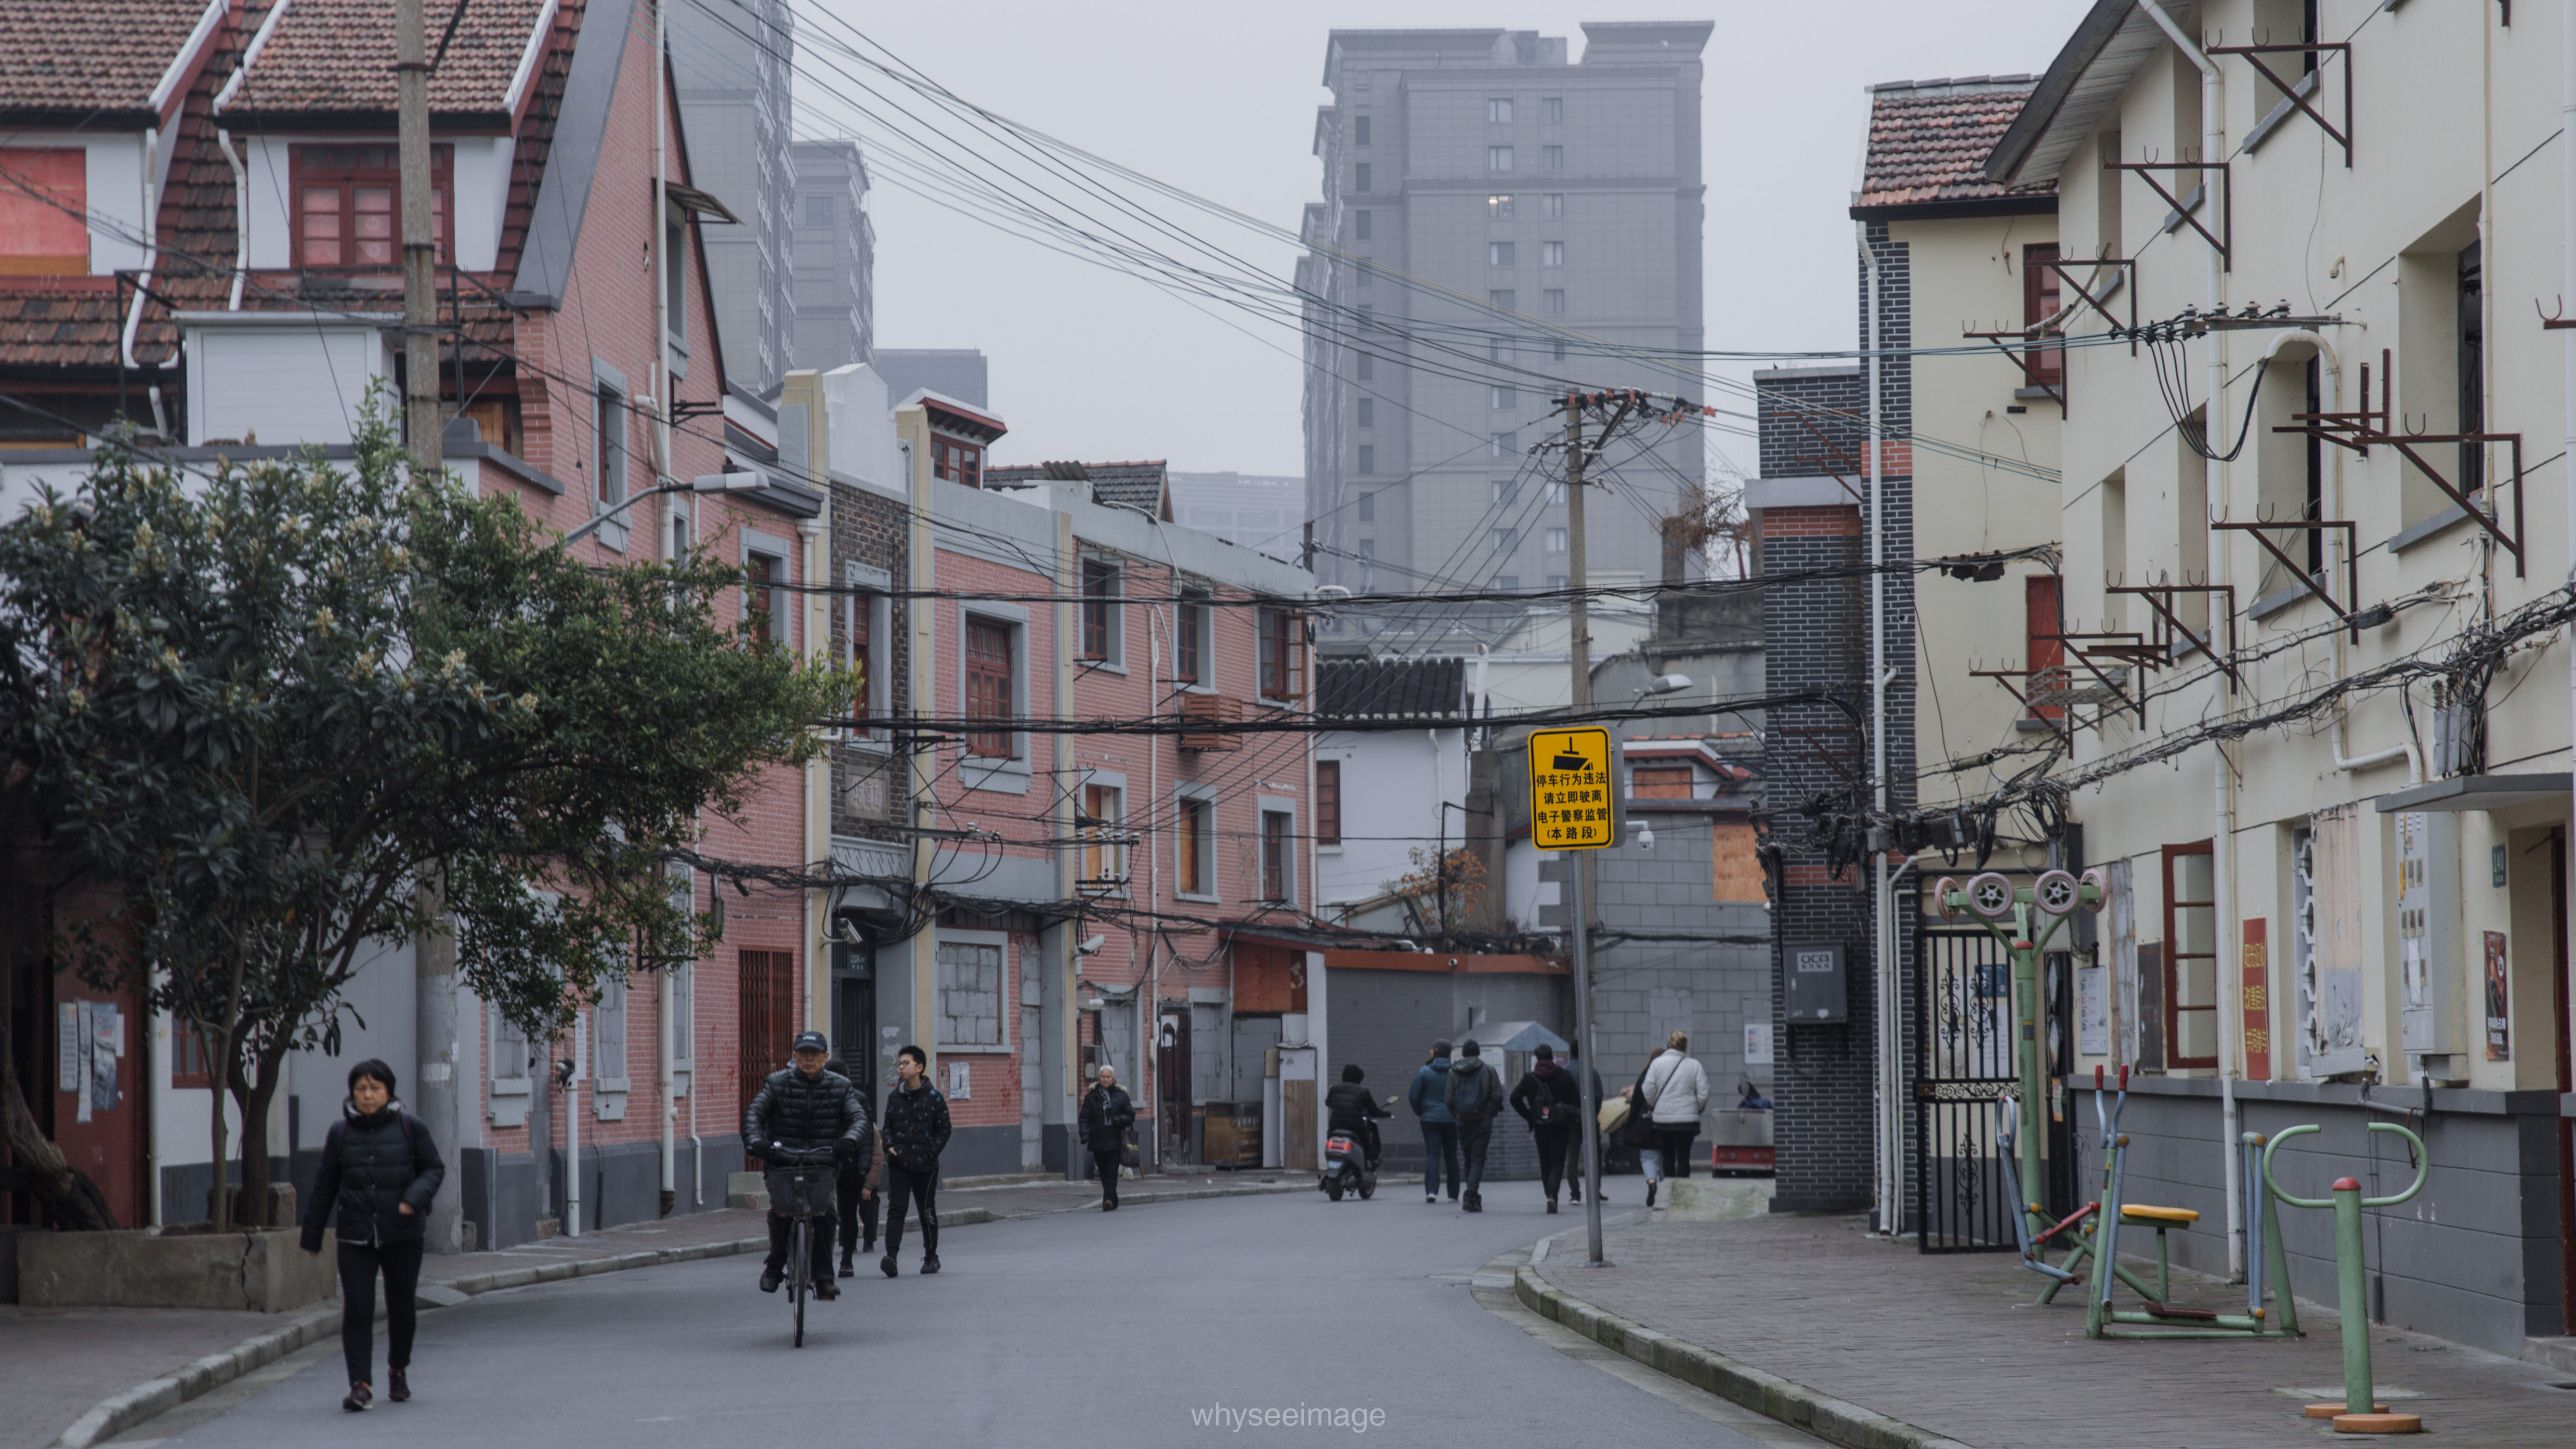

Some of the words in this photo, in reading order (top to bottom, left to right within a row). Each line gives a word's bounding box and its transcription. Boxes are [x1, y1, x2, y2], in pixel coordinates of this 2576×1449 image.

[1536, 771, 1606, 787] 停车行为违法
[1544, 790, 1602, 805] 请立即驶离
[1538, 808, 1607, 823] 电子警察监管
[2244, 984, 2265, 1010] 改善居住
[2246, 1027, 2267, 1053] 共同参与
